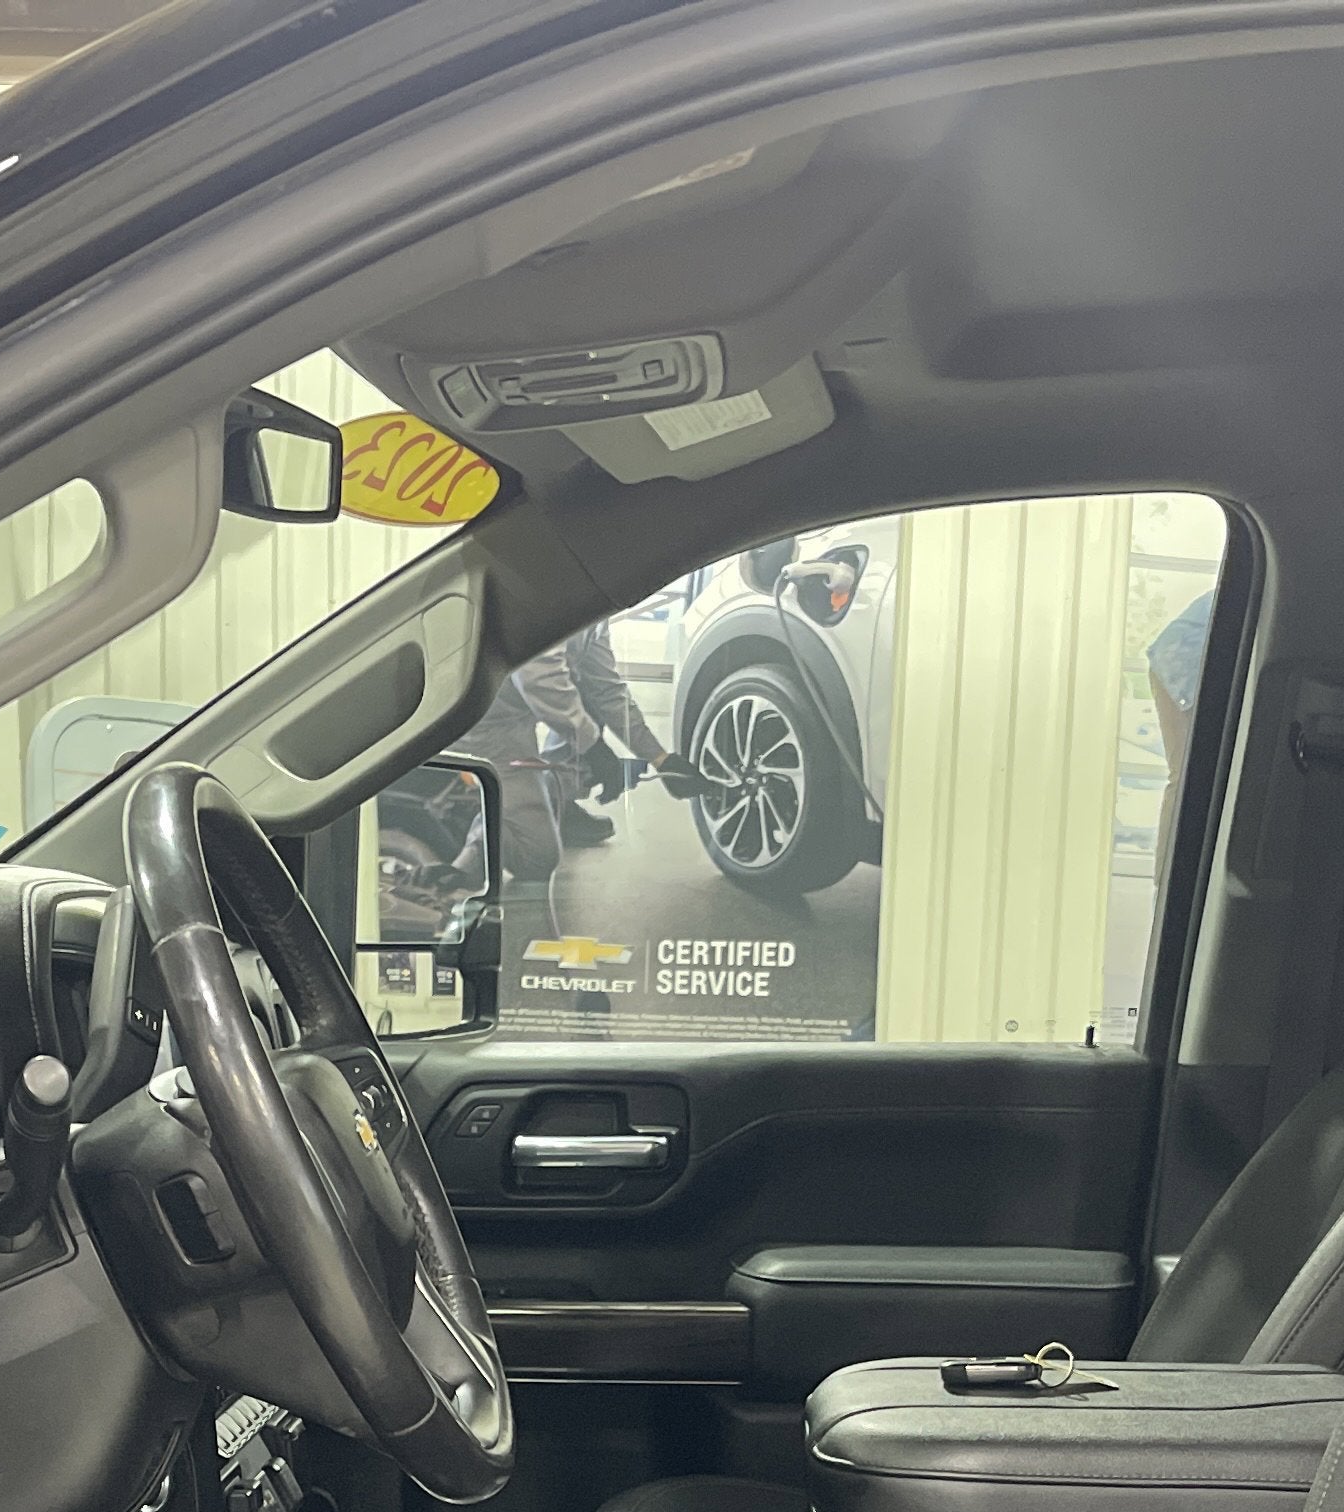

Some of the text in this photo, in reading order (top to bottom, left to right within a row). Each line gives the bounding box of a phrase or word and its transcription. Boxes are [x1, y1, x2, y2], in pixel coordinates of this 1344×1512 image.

[657, 939, 795, 967] CERTIFIED
[520, 975, 636, 993] CHEVROLET
[656, 970, 771, 997] SERVICE
